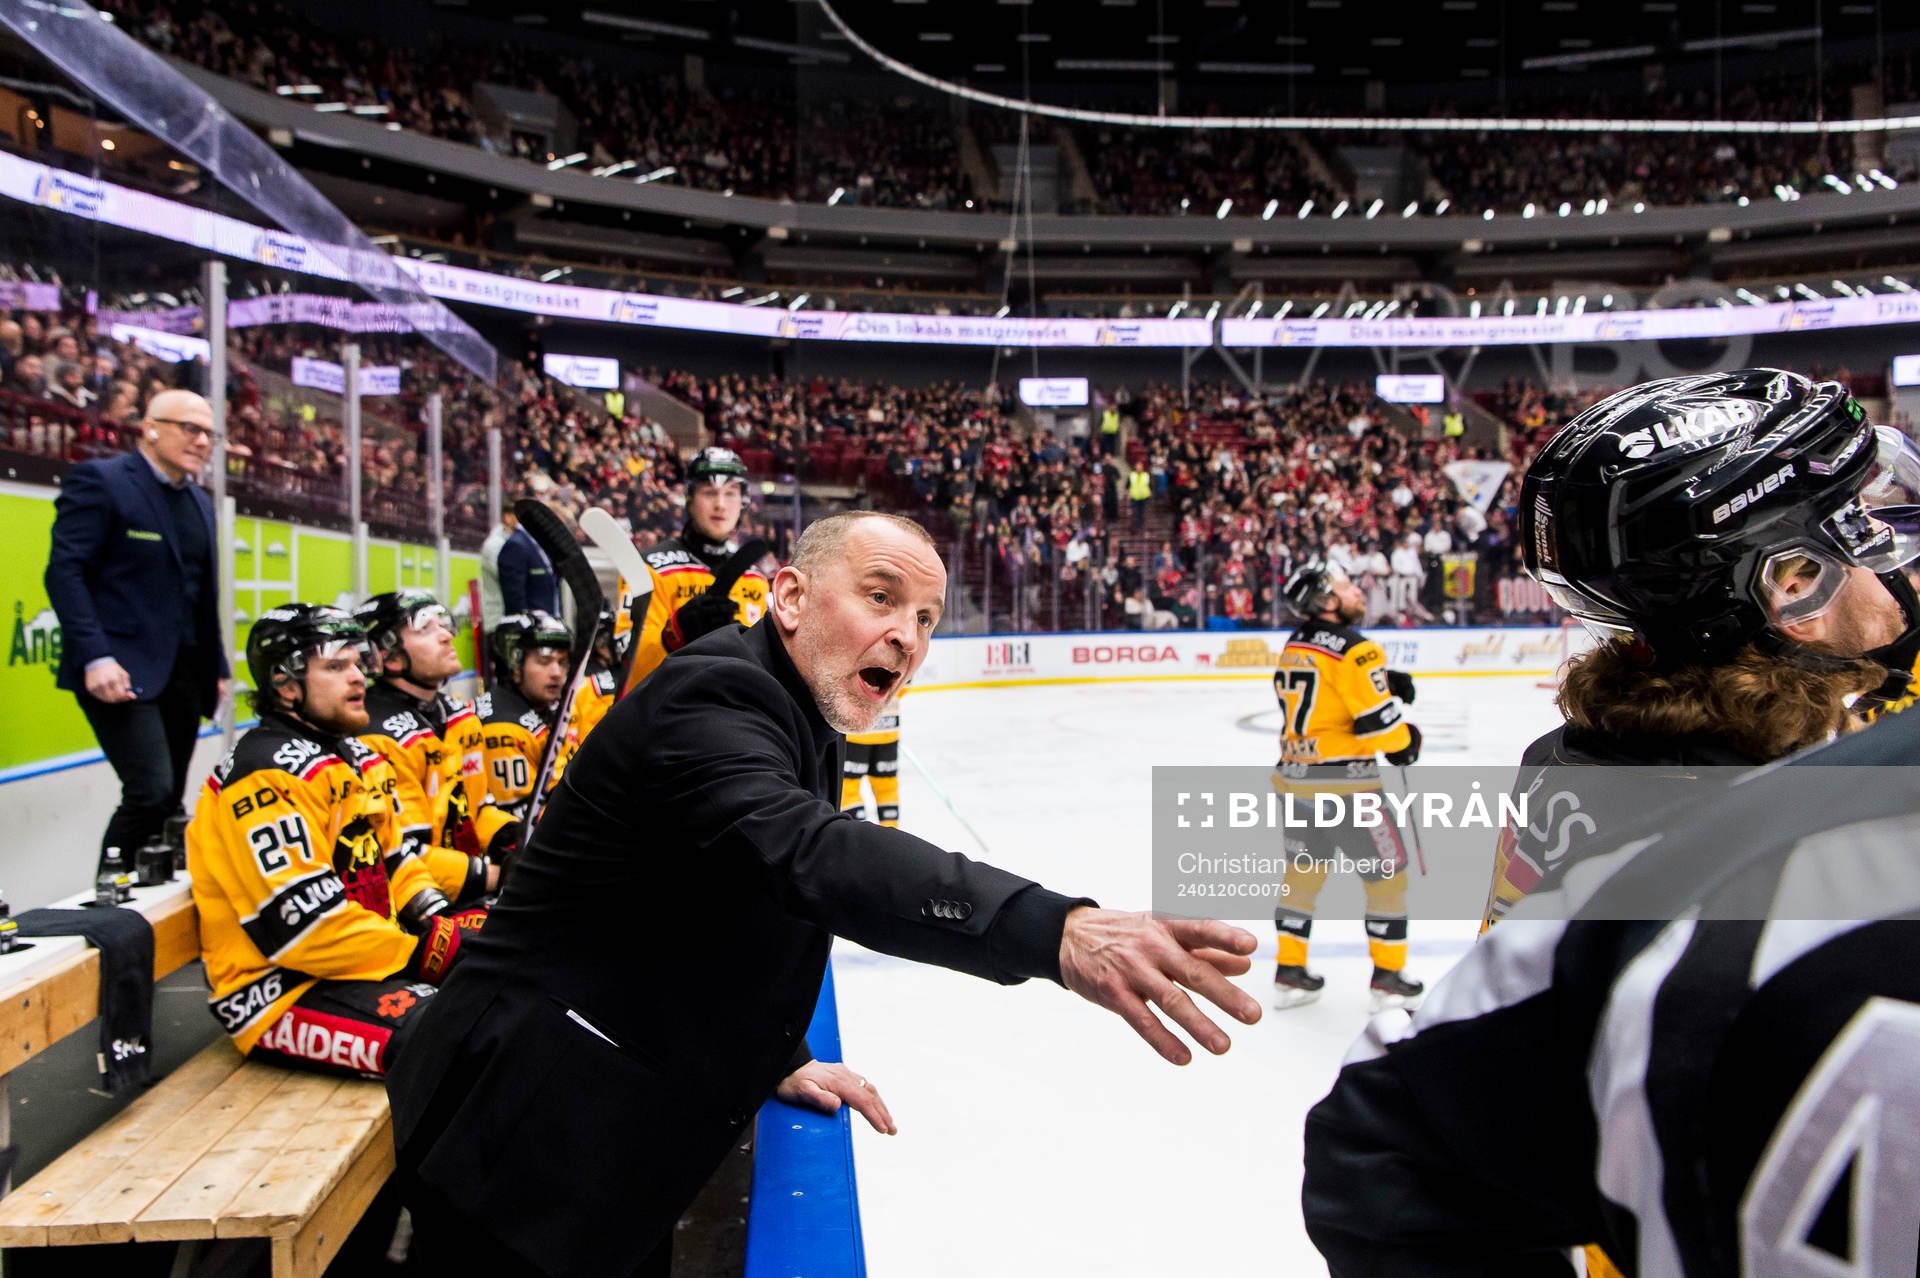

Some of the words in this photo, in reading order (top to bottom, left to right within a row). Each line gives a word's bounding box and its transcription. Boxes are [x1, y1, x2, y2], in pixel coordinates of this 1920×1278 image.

[1652, 398, 1758, 449] LKAB
[1072, 645, 1179, 664] BORGA
[493, 757, 528, 791] 40
[251, 814, 312, 875] 24
[217, 973, 283, 1029] SSAB
